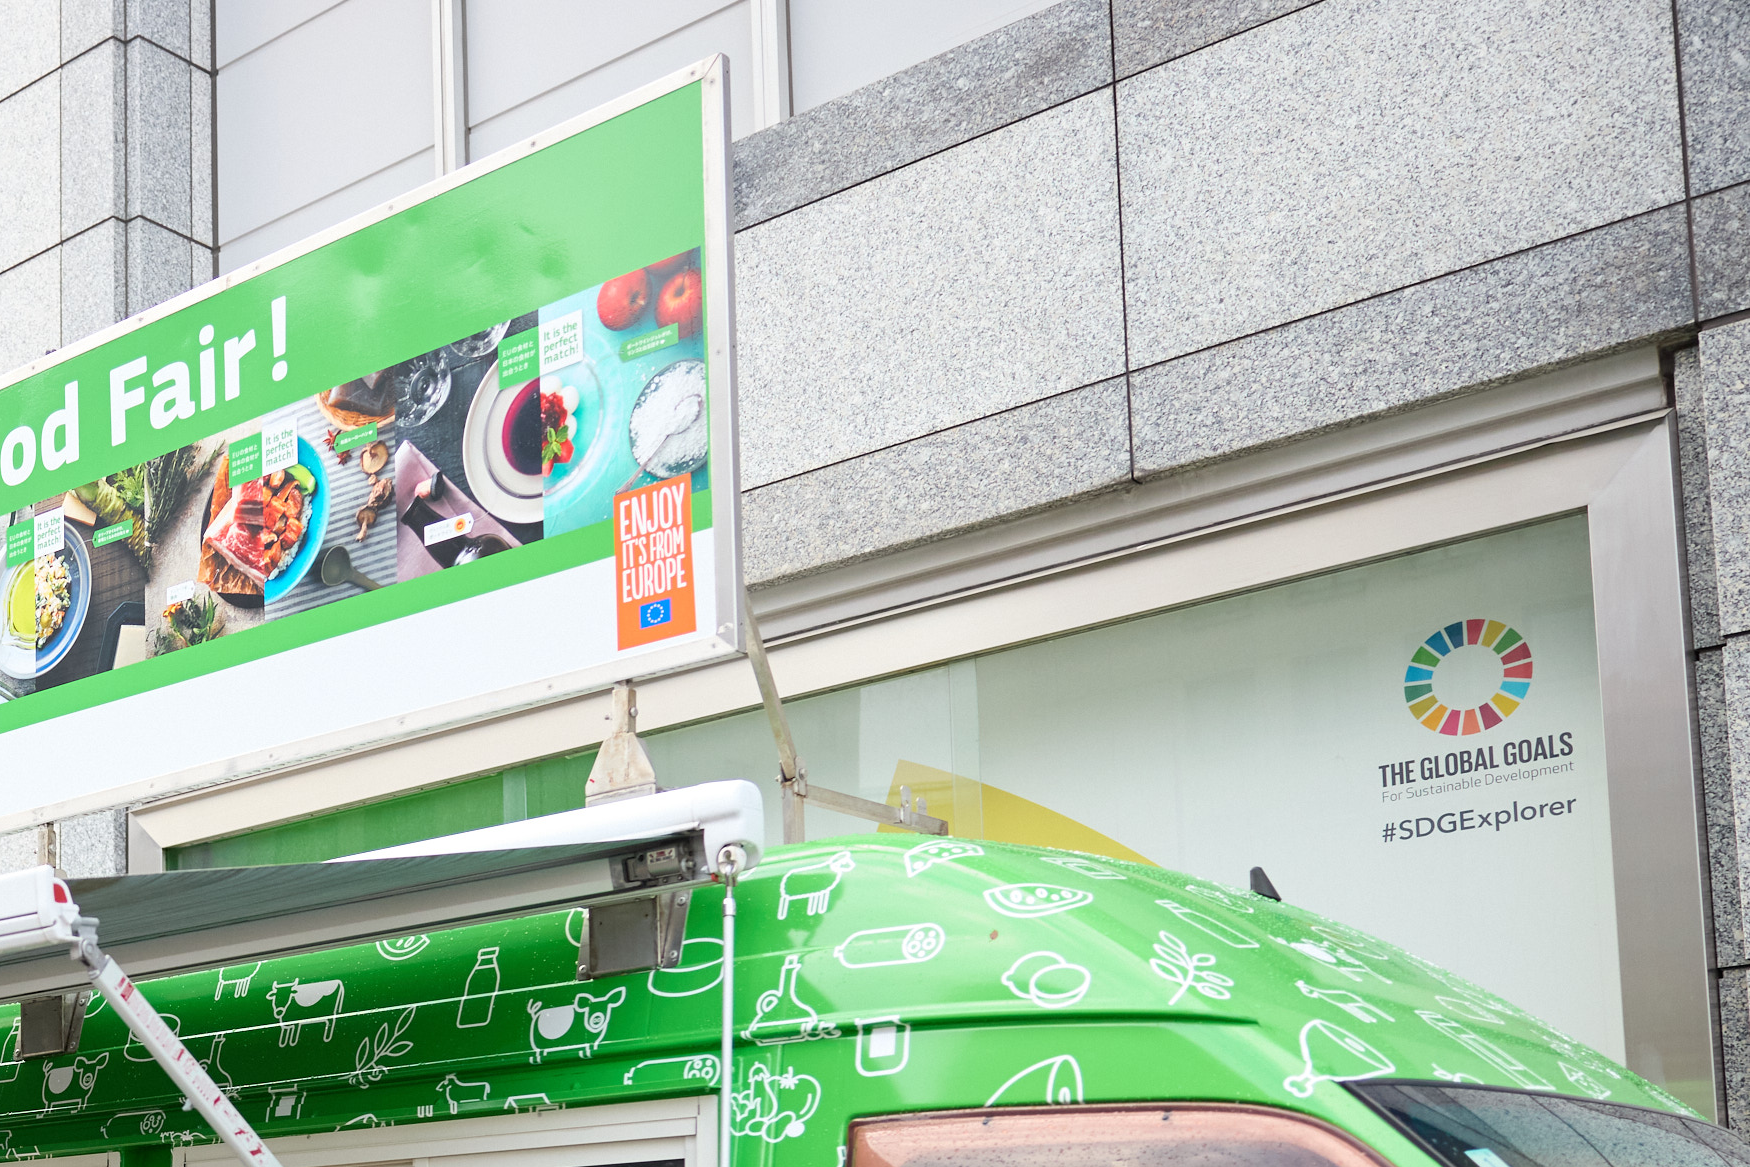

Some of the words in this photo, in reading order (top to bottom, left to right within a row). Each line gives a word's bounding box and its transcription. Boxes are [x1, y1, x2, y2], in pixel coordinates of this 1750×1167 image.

[543, 330, 550, 342] It
[552, 326, 560, 338] is
[562, 320, 577, 334] the
[543, 332, 577, 355] perfect
[265, 436, 271, 446] It
[273, 432, 279, 443] is
[280, 427, 293, 440] the
[265, 439, 293, 458] perfect
[50, 516, 60, 526] the
[619, 483, 685, 541] ENJOY
[36, 525, 60, 542] perfect
[623, 536, 647, 569] IT'S
[650, 525, 685, 562] FROM
[622, 554, 687, 603] EUROPE
[1379, 760, 1416, 788] THE
[1420, 745, 1500, 781] GLOBAL
[1503, 732, 1574, 765] GOALS
[1382, 791, 1402, 803] For
[1406, 776, 1482, 799] Sustainable
[1485, 761, 1575, 786] Development
[1381, 798, 1577, 843] #SDGExplorer
